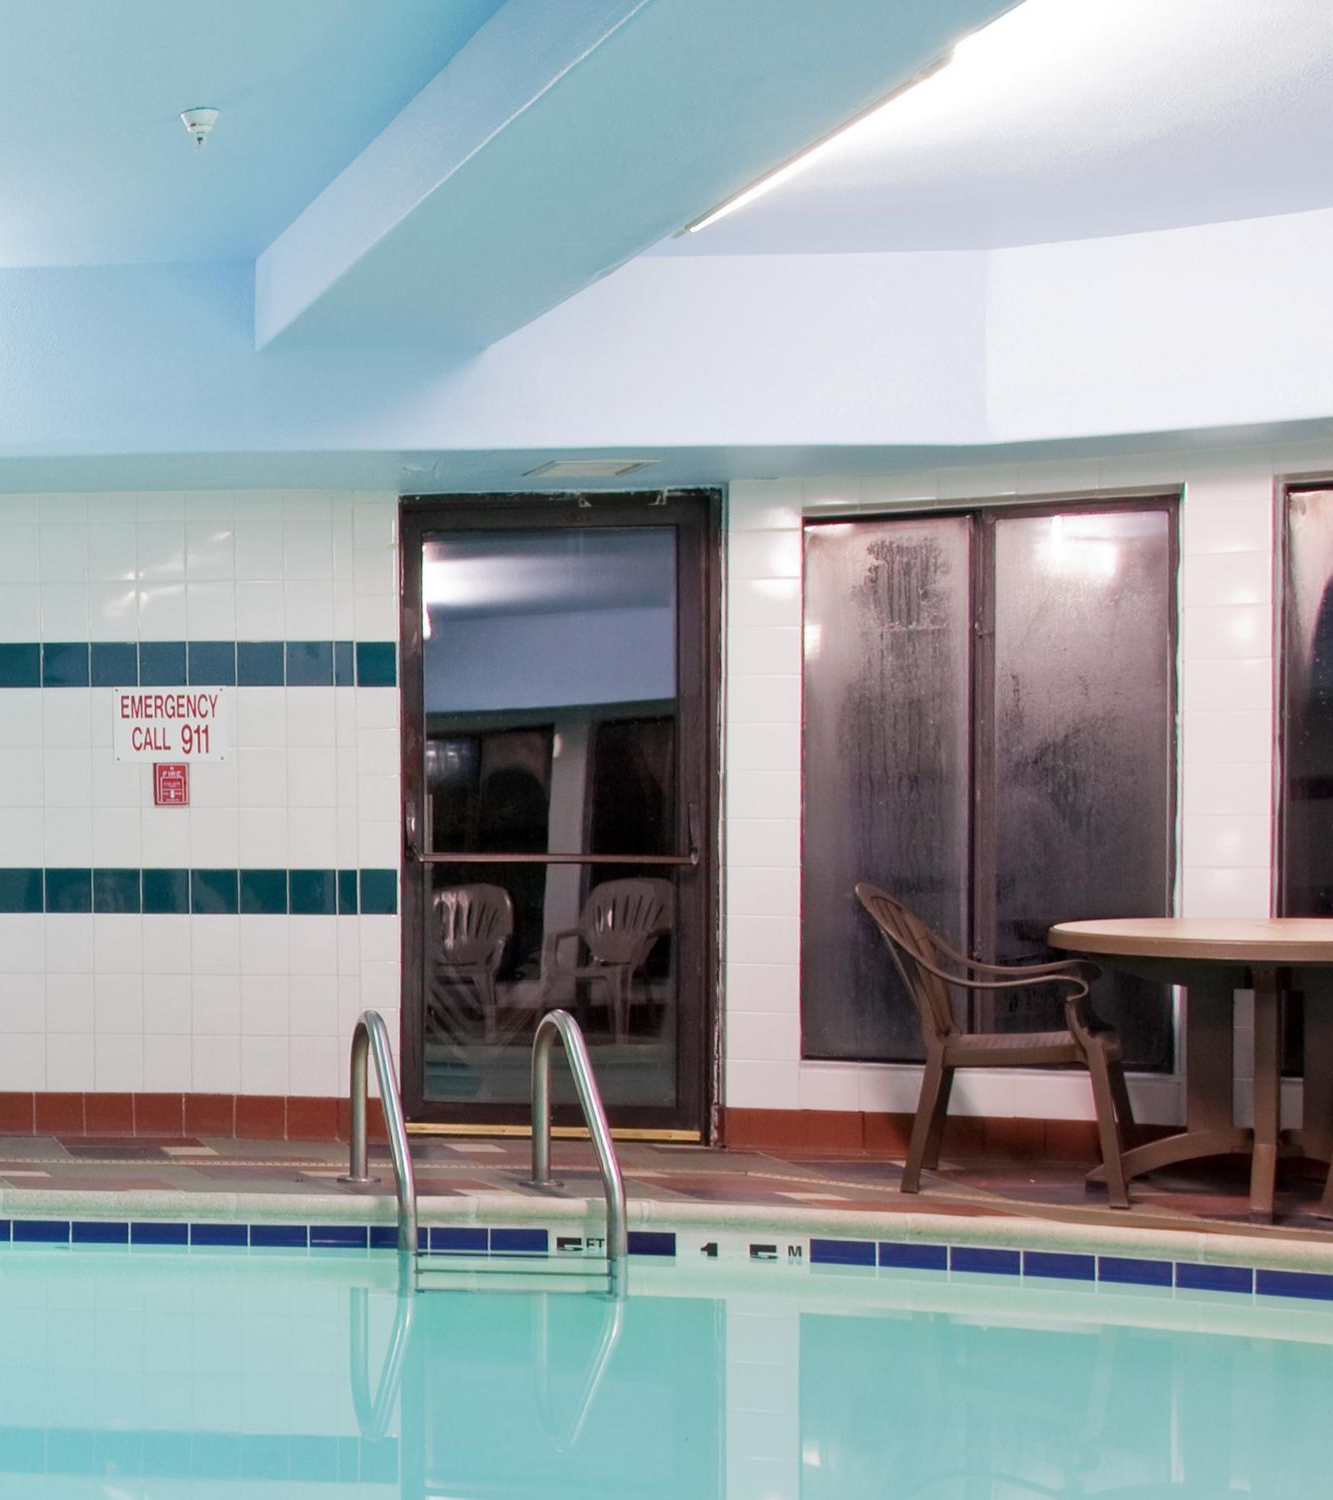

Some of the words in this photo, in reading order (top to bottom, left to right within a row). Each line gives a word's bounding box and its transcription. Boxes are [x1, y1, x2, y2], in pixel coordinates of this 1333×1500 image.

[121, 694, 218, 719] EMERGENCY
[132, 727, 171, 751] CALL
[181, 724, 209, 754] 911
[586, 1238, 605, 1248] FT
